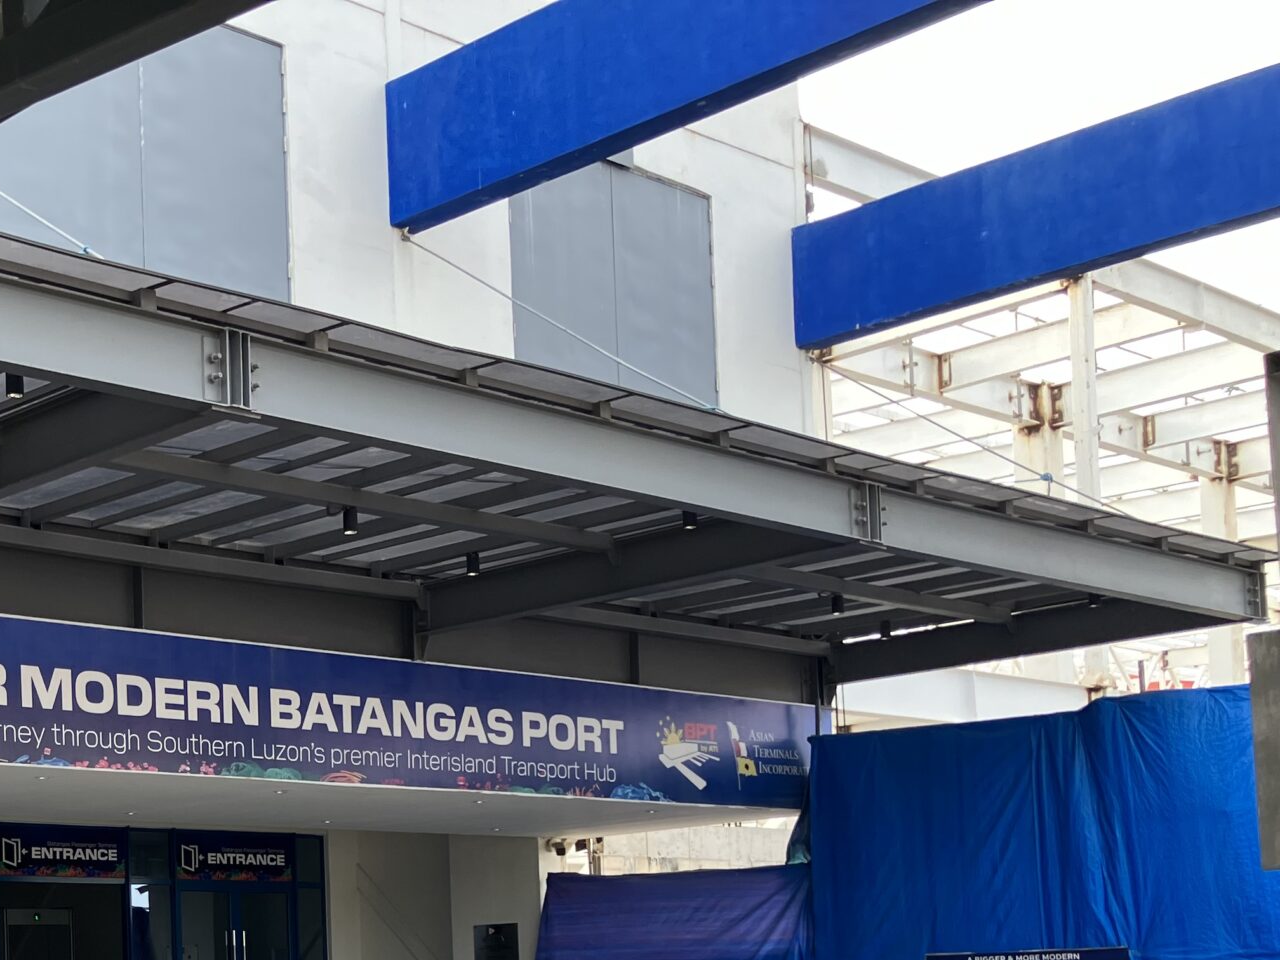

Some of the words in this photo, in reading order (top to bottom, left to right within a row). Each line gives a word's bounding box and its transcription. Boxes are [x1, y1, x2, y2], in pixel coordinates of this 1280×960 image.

[20, 664, 259, 727] MODERN
[270, 687, 515, 747] BATANGAS
[522, 711, 624, 755] PORT
[684, 722, 717, 740] BPT
[51, 726, 142, 756] through
[146, 731, 245, 759] Southern
[250, 737, 326, 764] Luzon's
[330, 746, 404, 769] premier
[407, 748, 497, 776] Interisland
[500, 756, 581, 782] Transport
[584, 763, 617, 783] Hub
[31, 846, 118, 861] ENTRANCE
[207, 852, 286, 866] ENTRANCE
[1042, 952, 1081, 960] MODERN
